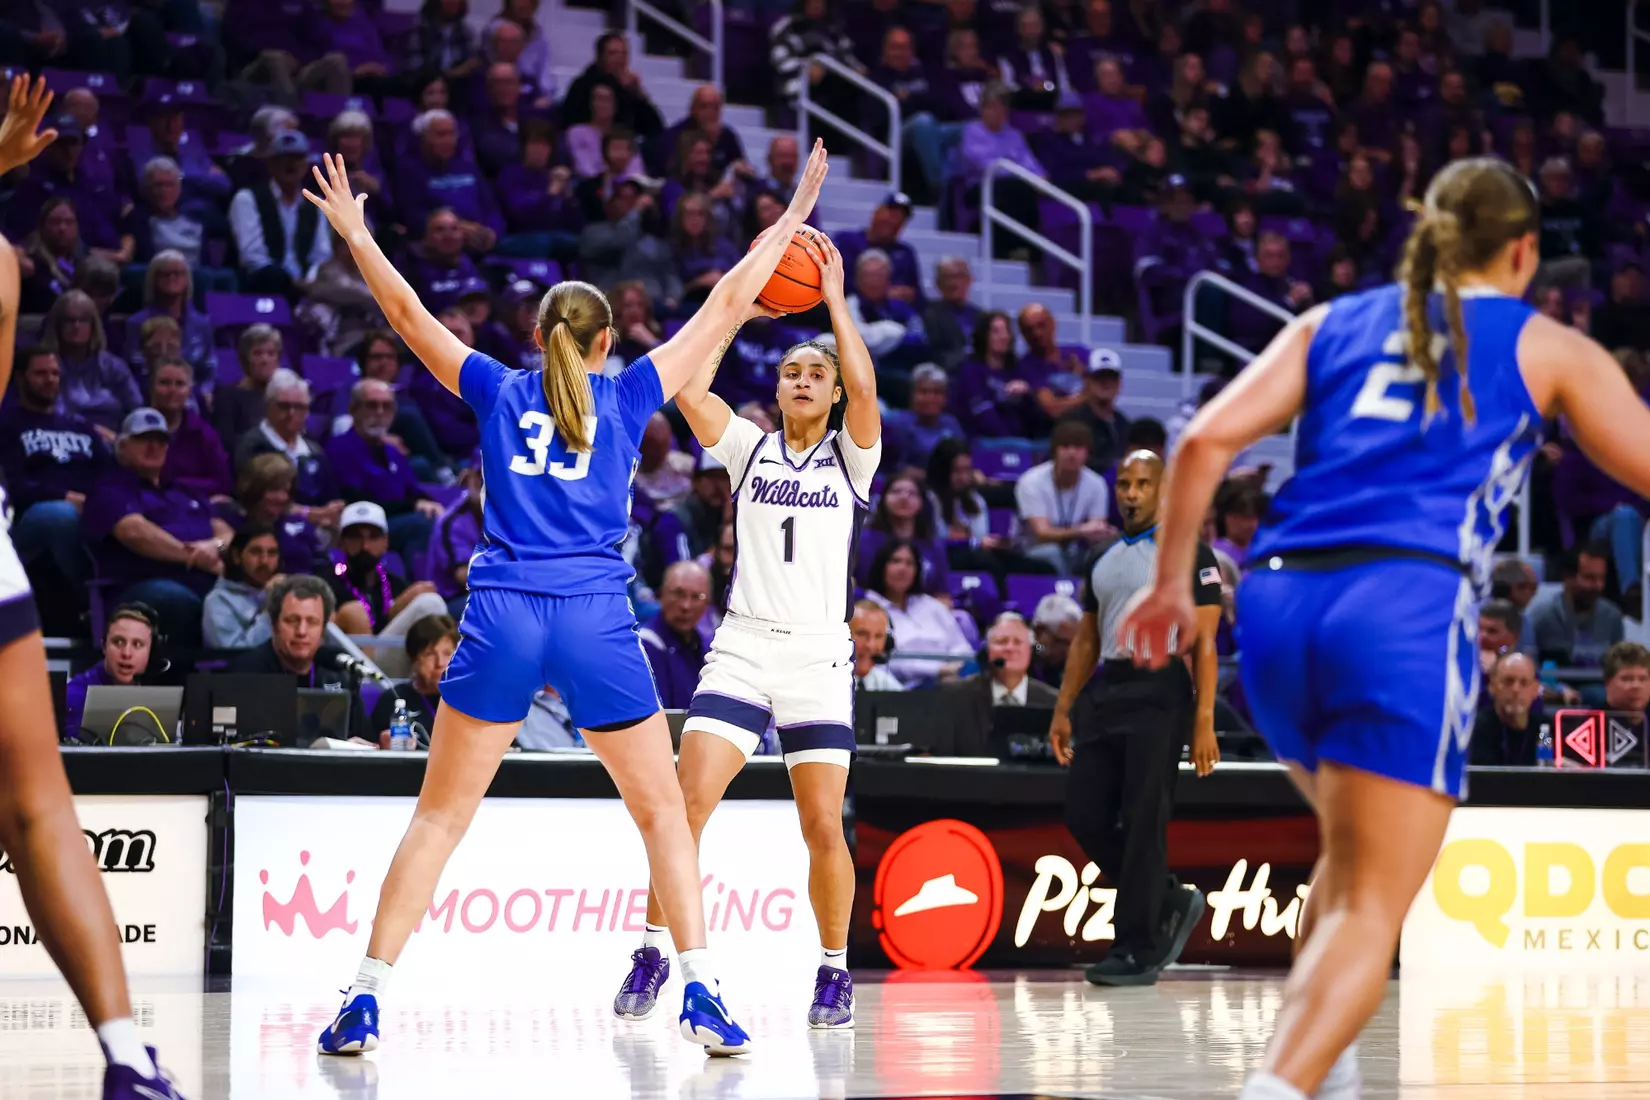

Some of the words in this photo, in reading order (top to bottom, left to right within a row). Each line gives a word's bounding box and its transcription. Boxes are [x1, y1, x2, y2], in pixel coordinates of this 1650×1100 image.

[508, 410, 598, 481] 33
[751, 475, 840, 508] Wildcats
[780, 514, 796, 564] 1
[371, 888, 650, 933] MOOTHIE
[1014, 854, 1118, 948] Piz
